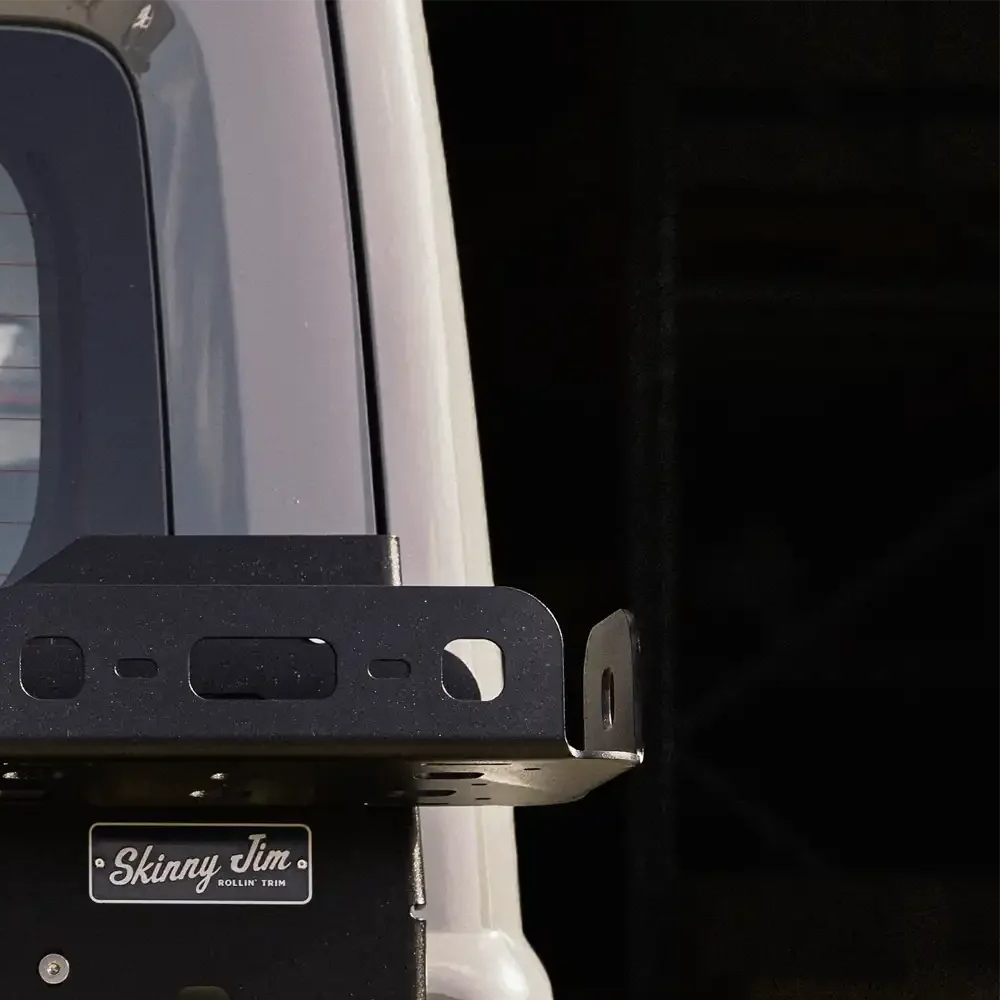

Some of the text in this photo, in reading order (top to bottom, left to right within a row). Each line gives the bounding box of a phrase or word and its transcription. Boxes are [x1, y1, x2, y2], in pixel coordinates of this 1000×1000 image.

[109, 833, 292, 894] Skinny Jim
[261, 879, 286, 887] TRIM
